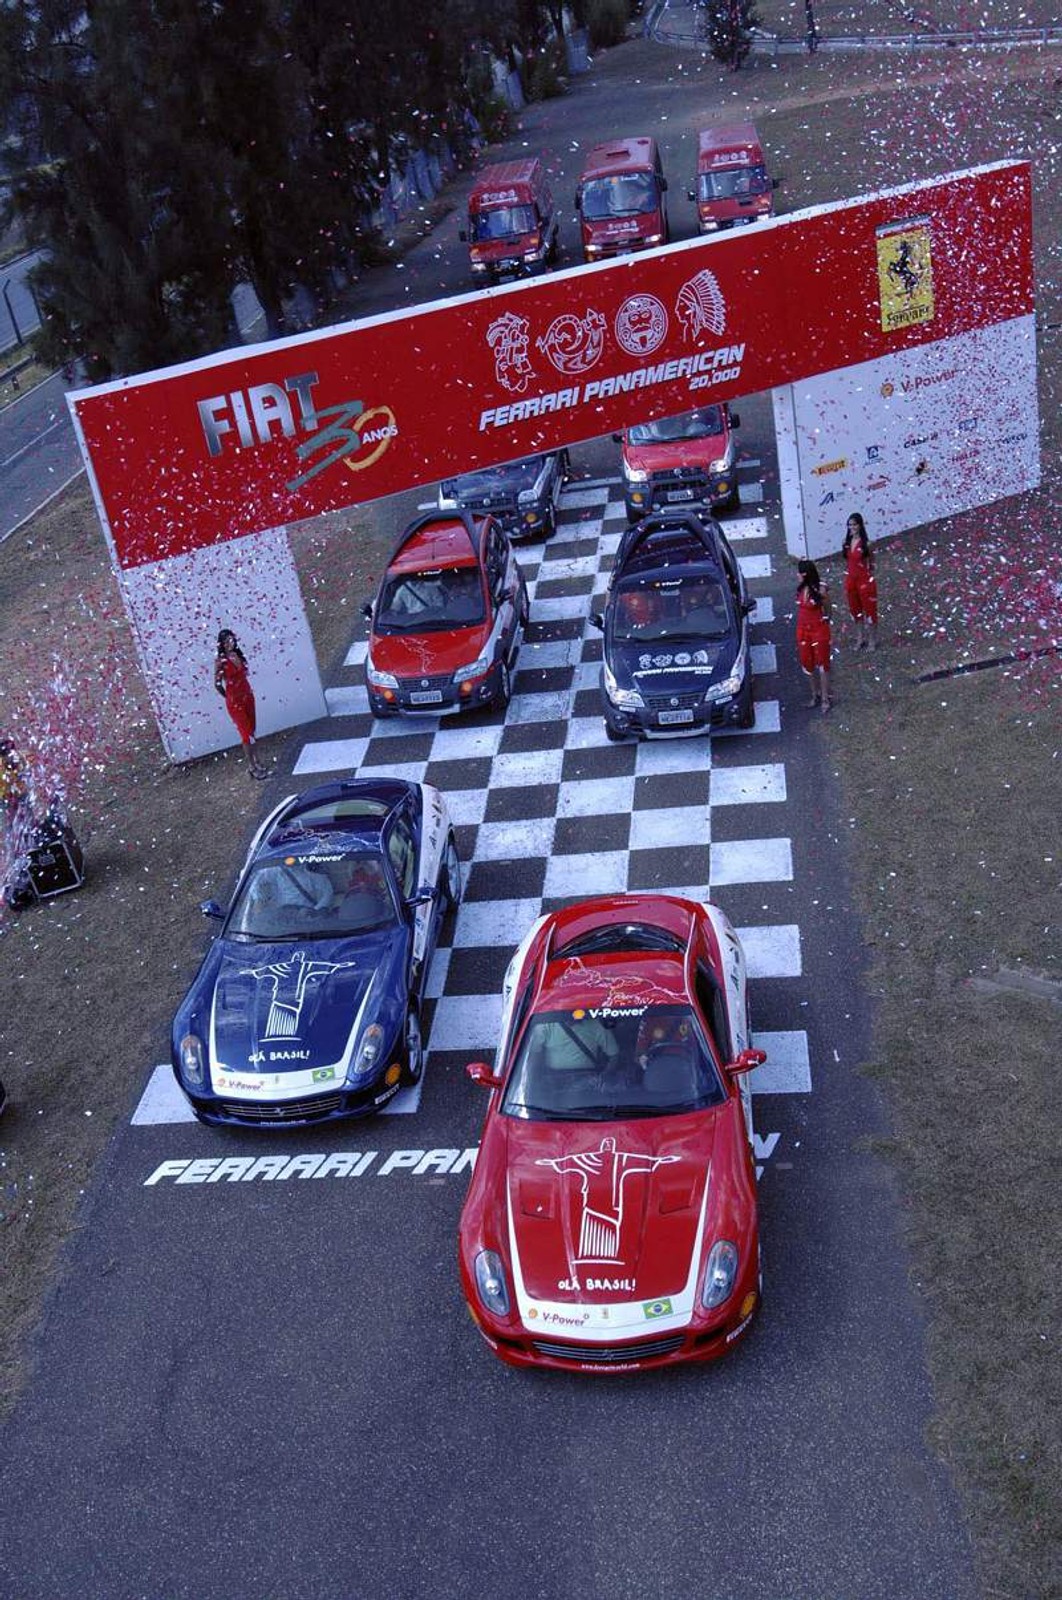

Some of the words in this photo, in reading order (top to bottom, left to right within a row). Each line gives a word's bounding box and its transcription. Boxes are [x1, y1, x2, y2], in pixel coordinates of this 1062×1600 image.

[479, 387, 577, 431] FERRARI
[584, 343, 746, 402] PANAMERICAN
[689, 367, 741, 391] 20,000
[901, 369, 956, 393] V-Power
[197, 371, 319, 458] FIAT
[362, 424, 398, 444] ANOS
[298, 855, 344, 864] V-Power
[589, 1007, 646, 1018] V-Power
[143, 1151, 378, 1185] FERRARI
[557, 1278, 581, 1291] OLÁ
[586, 1279, 636, 1292] BRASIL!
[542, 1311, 585, 1327] V-Power
